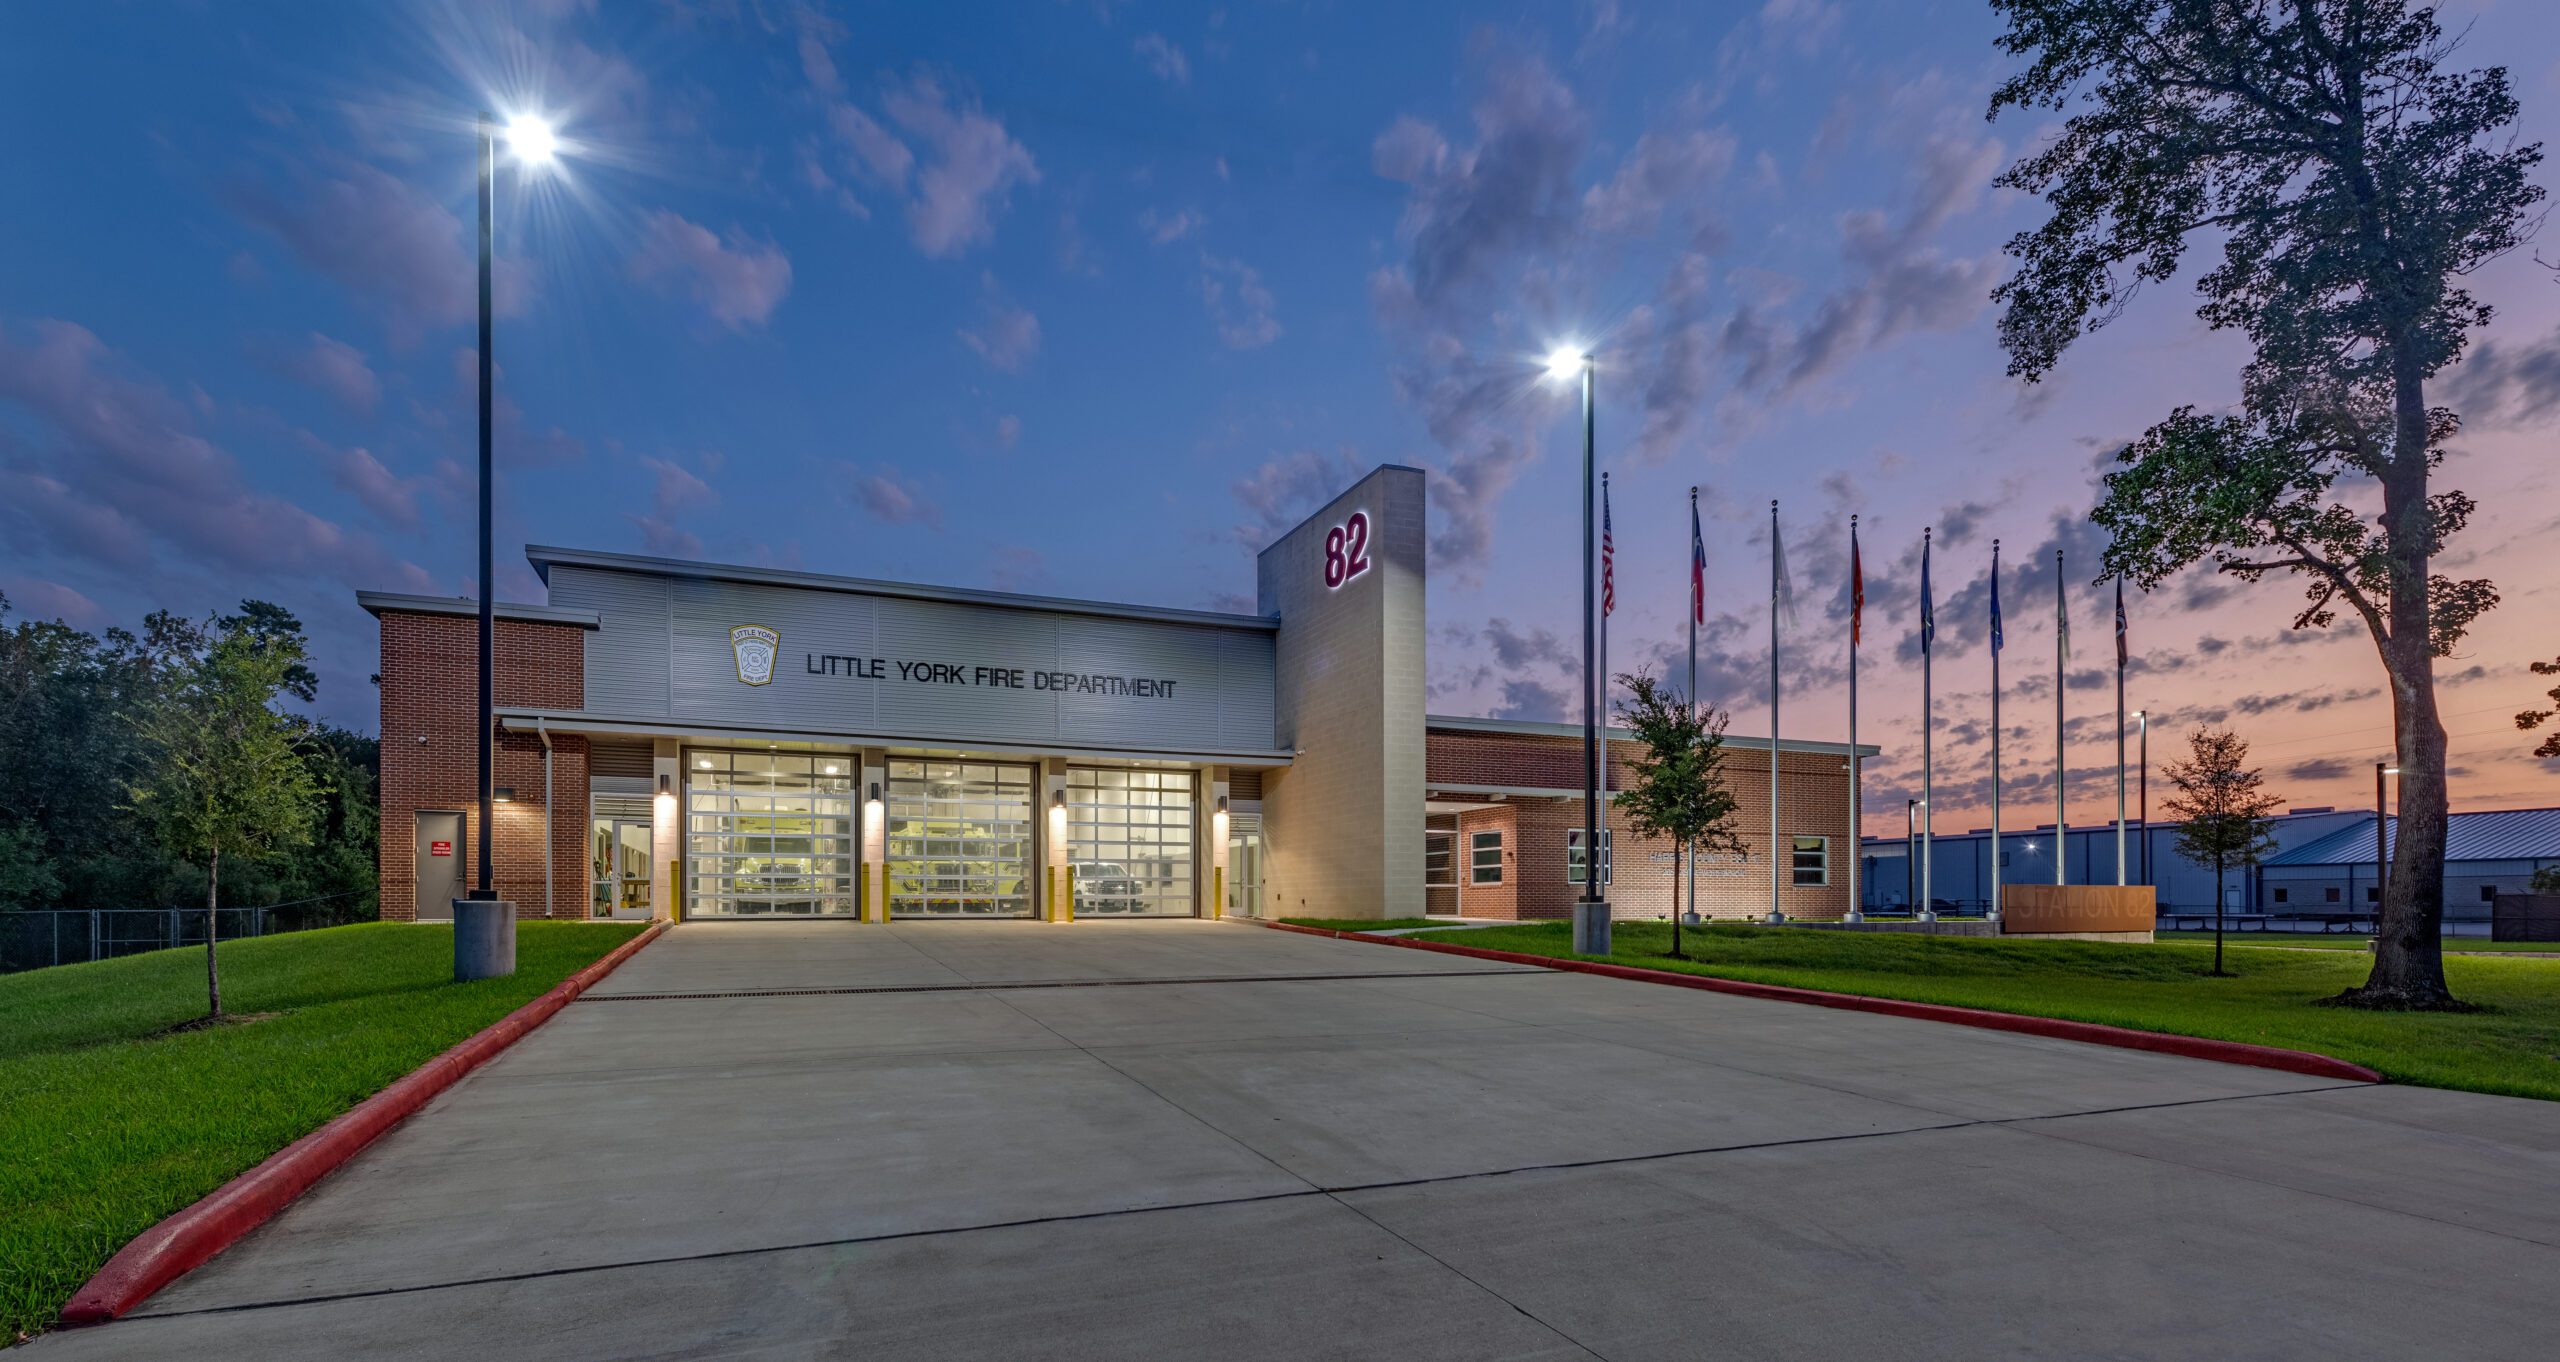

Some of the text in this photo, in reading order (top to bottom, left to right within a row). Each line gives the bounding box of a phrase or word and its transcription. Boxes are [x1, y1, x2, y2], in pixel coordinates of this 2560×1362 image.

[1325, 512, 1369, 589] 82
[734, 629, 776, 642] LITTLE YORK
[806, 653, 1177, 698] LITTLE YORK FIRE DEPARTMENT
[1648, 852, 1684, 862] HARRS
[1692, 853, 1728, 863] OUNTY
[2019, 888, 2151, 918] STATION 82
